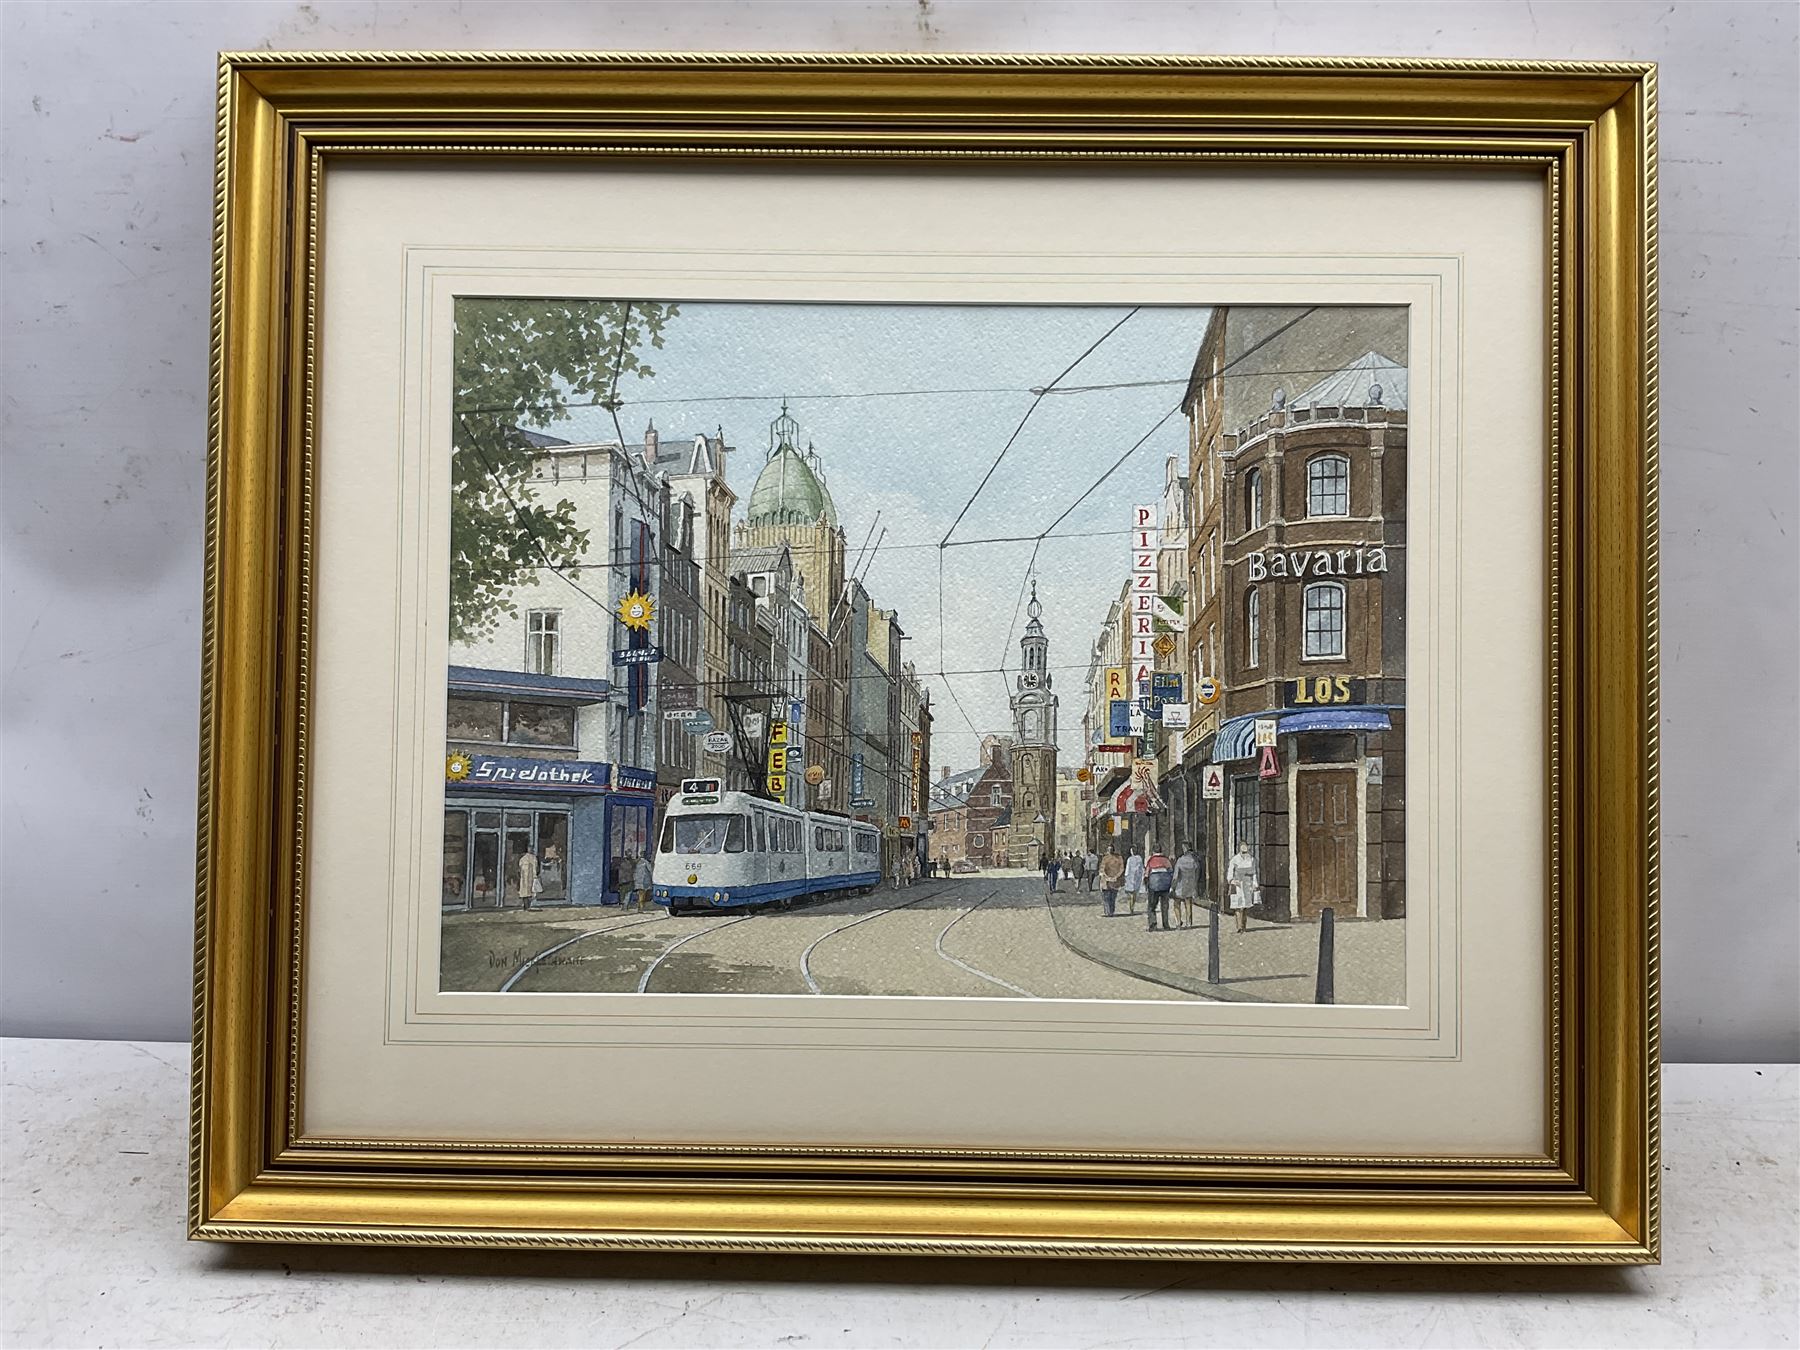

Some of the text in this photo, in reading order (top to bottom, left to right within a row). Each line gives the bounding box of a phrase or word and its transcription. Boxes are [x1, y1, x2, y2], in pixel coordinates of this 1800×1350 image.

[1249, 547, 1388, 581] Bavaria
[1136, 509, 1152, 683] PIZZERIA
[1294, 676, 1351, 703] LOS
[1130, 709, 1142, 717] LA
[689, 782, 699, 792] 4
